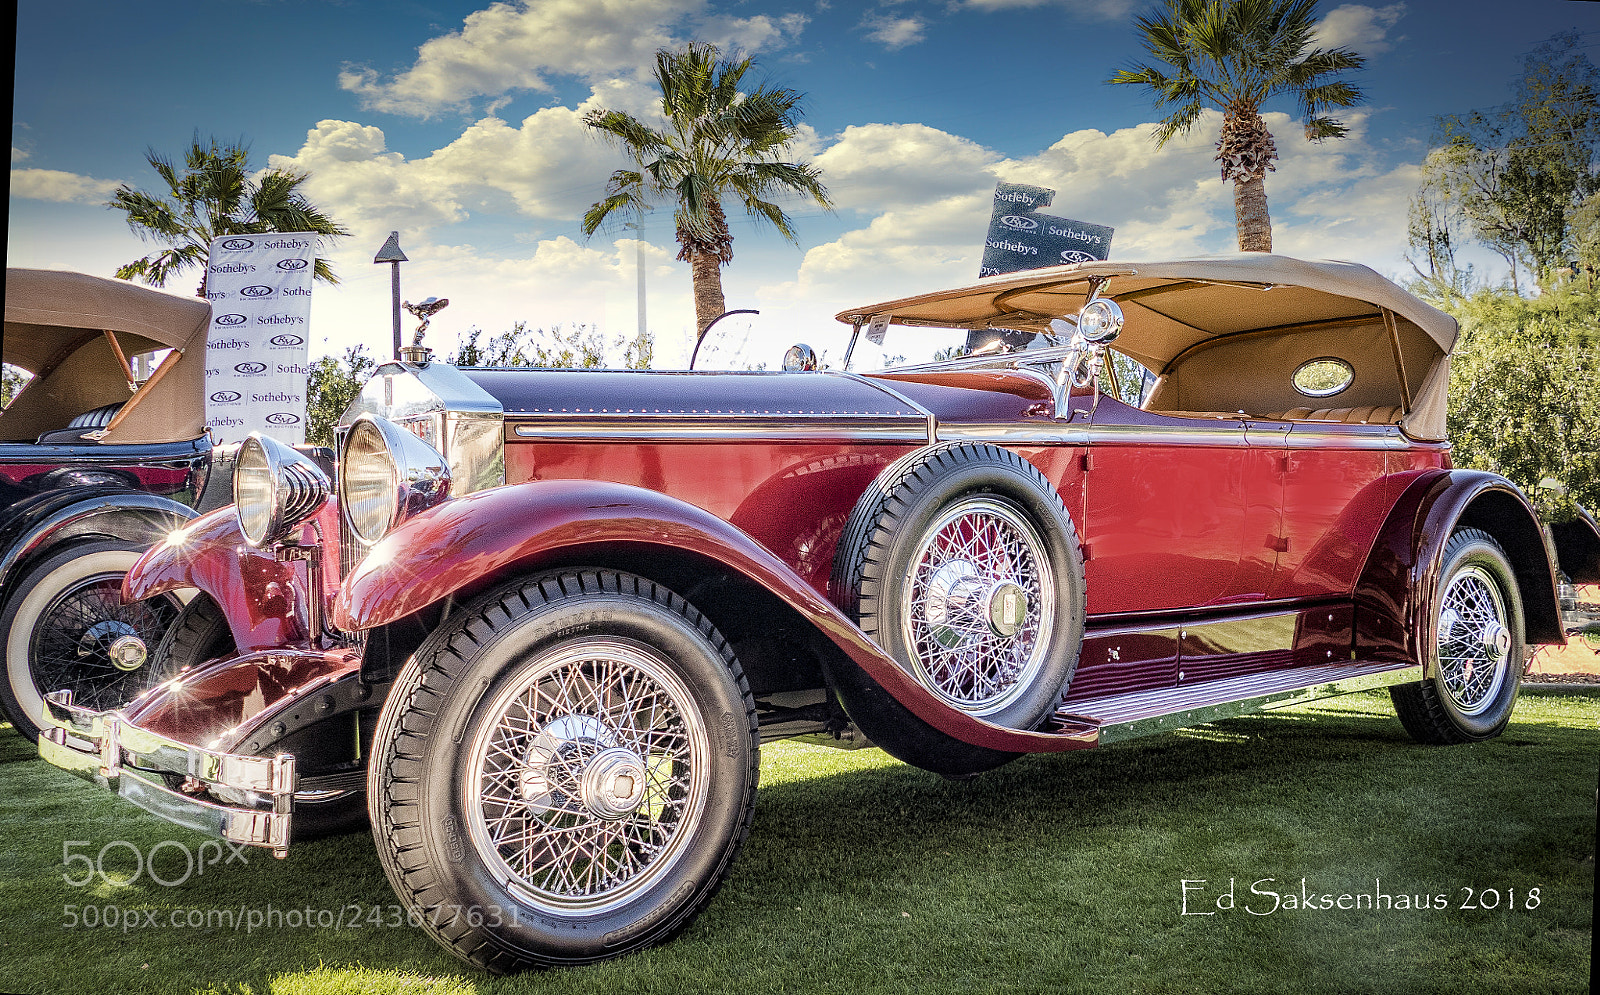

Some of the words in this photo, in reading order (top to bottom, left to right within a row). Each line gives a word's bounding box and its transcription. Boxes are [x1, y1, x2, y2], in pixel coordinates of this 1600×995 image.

[1048, 226, 1101, 244] Sotheby's
[264, 239, 310, 250] Sotheby's
[985, 238, 1038, 256] Sotheby's
[209, 263, 256, 274] Sotheby's
[282, 286, 311, 297] Sothe
[257, 315, 304, 325] Sotheby's
[206, 339, 250, 350] Sotheby's
[252, 392, 300, 404] Sotheby's
[206, 417, 244, 428] otheby's
